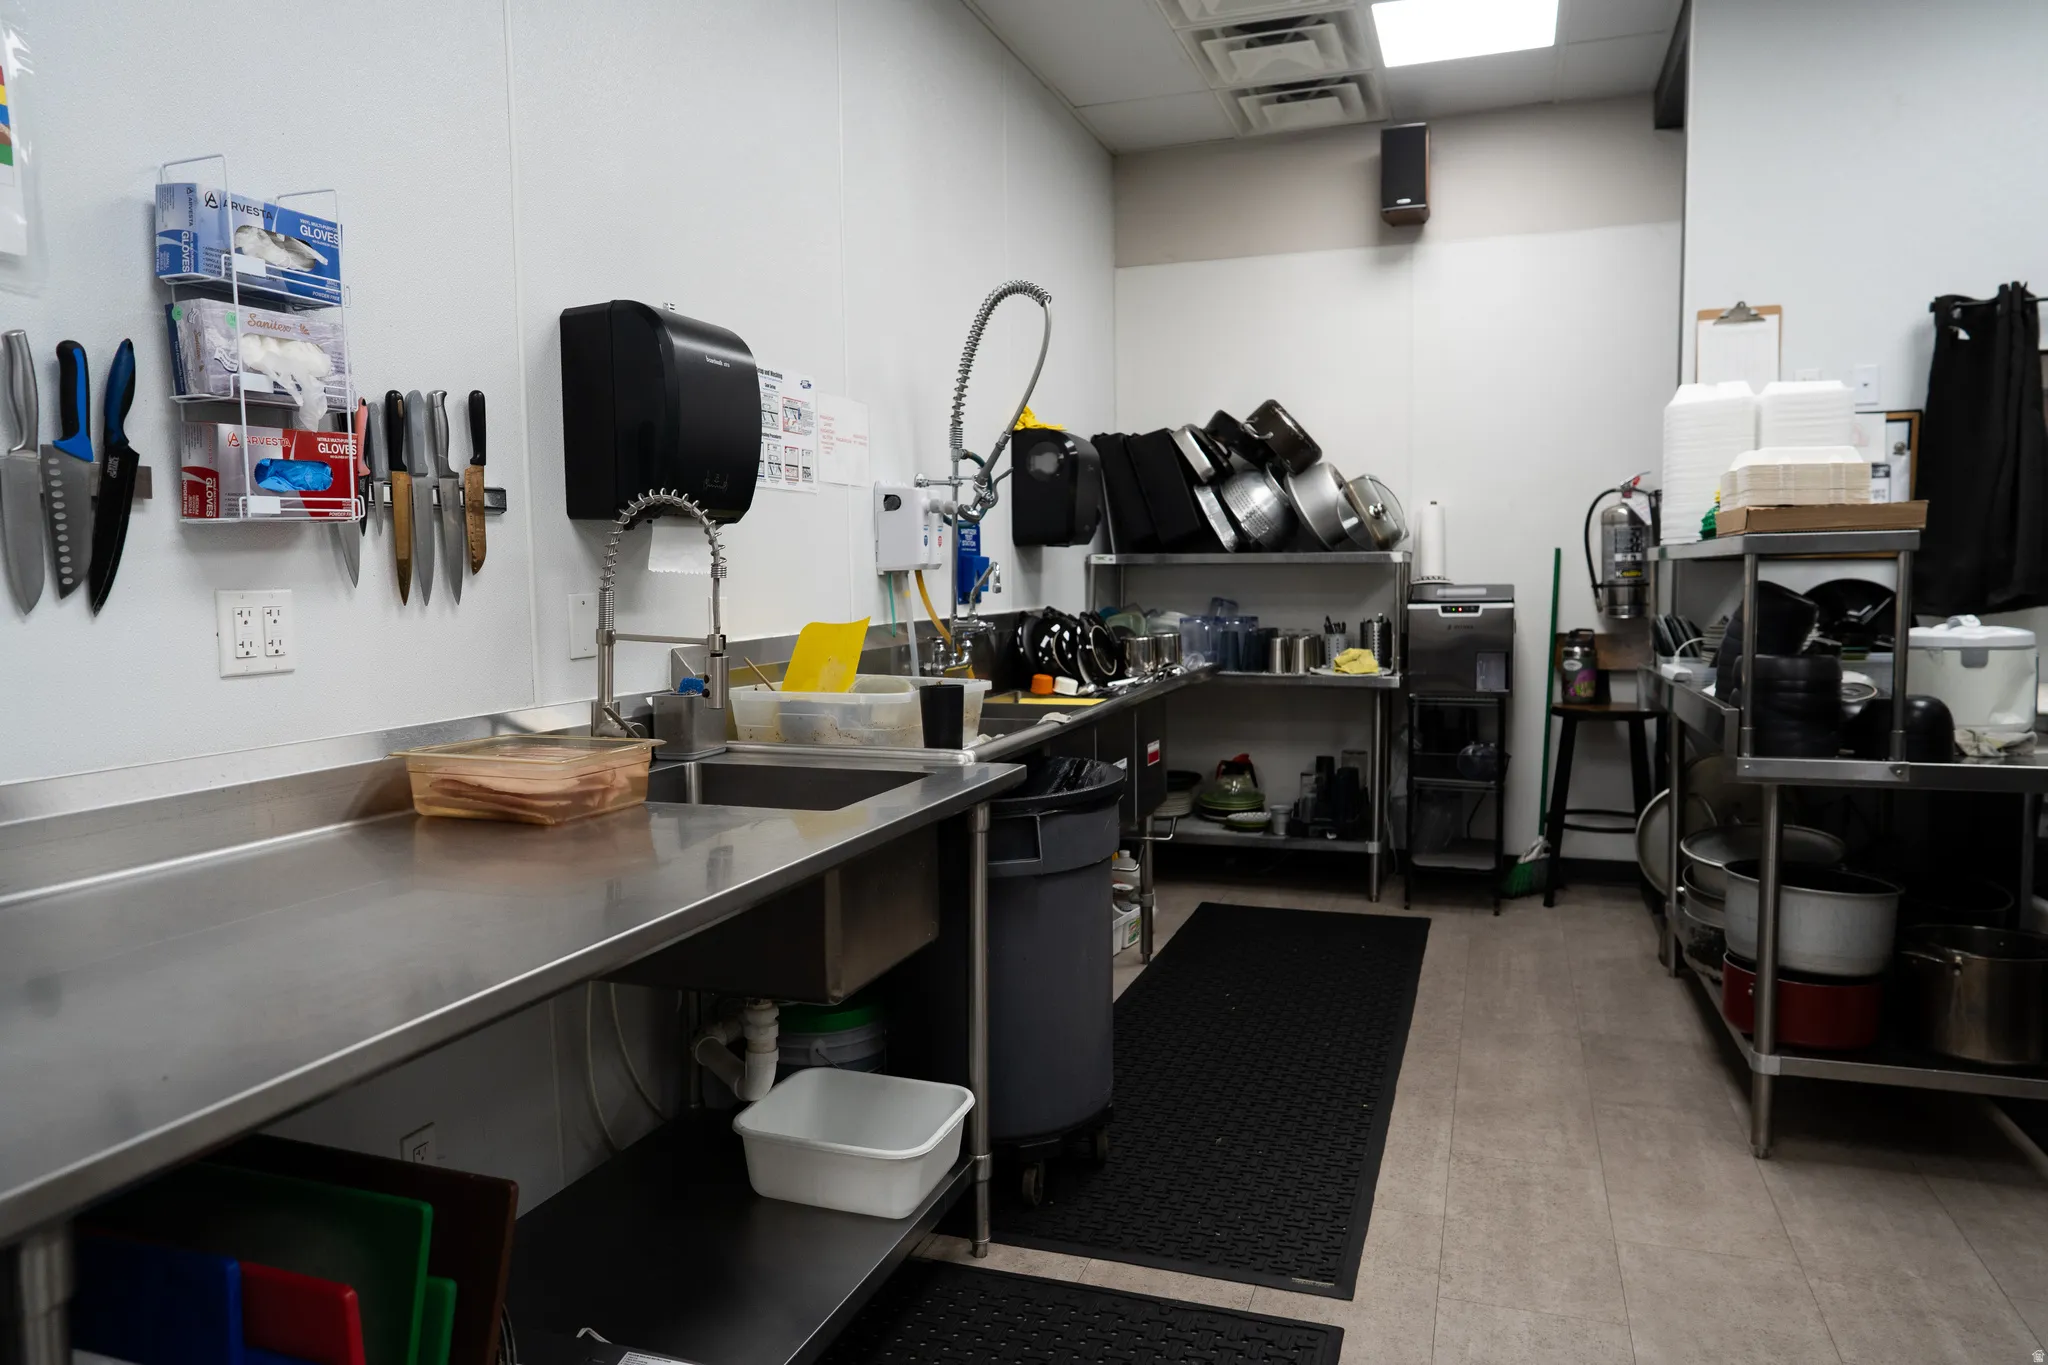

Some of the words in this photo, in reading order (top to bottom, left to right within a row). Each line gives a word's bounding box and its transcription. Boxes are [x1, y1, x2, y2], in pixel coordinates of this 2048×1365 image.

[300, 224, 339, 245] GLOVES
[181, 230, 190, 273] GLOVES
[246, 435, 292, 448] ARVESTA
[318, 443, 357, 455] GLOVES
[205, 477, 213, 518] GLOVES
